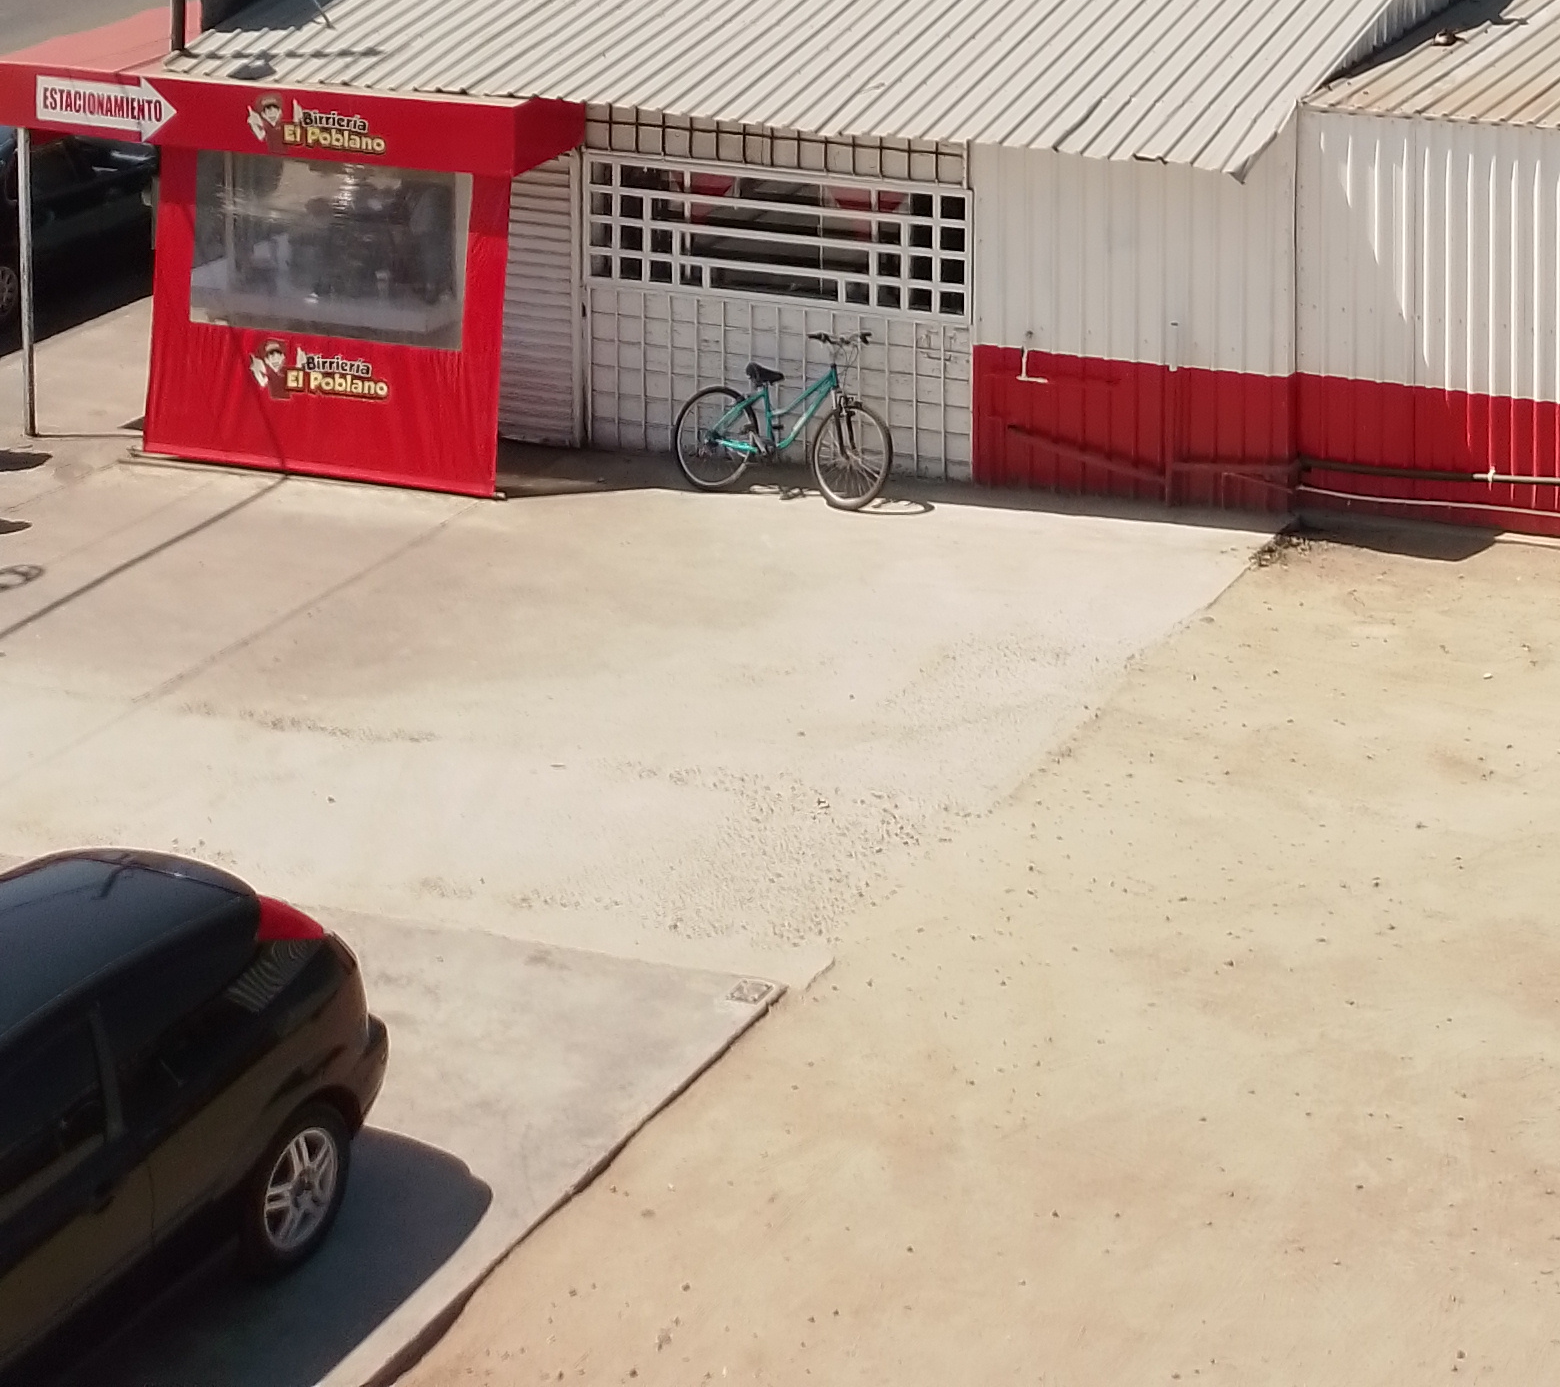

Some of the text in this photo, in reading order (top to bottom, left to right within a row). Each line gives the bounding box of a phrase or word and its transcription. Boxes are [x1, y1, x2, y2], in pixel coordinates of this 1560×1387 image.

[42, 86, 163, 123] ESTACIONAMIENTO
[302, 109, 368, 132] Birriería
[283, 125, 386, 154] El Poblano
[305, 354, 371, 376] Birriería
[285, 369, 388, 397] El Poblano
